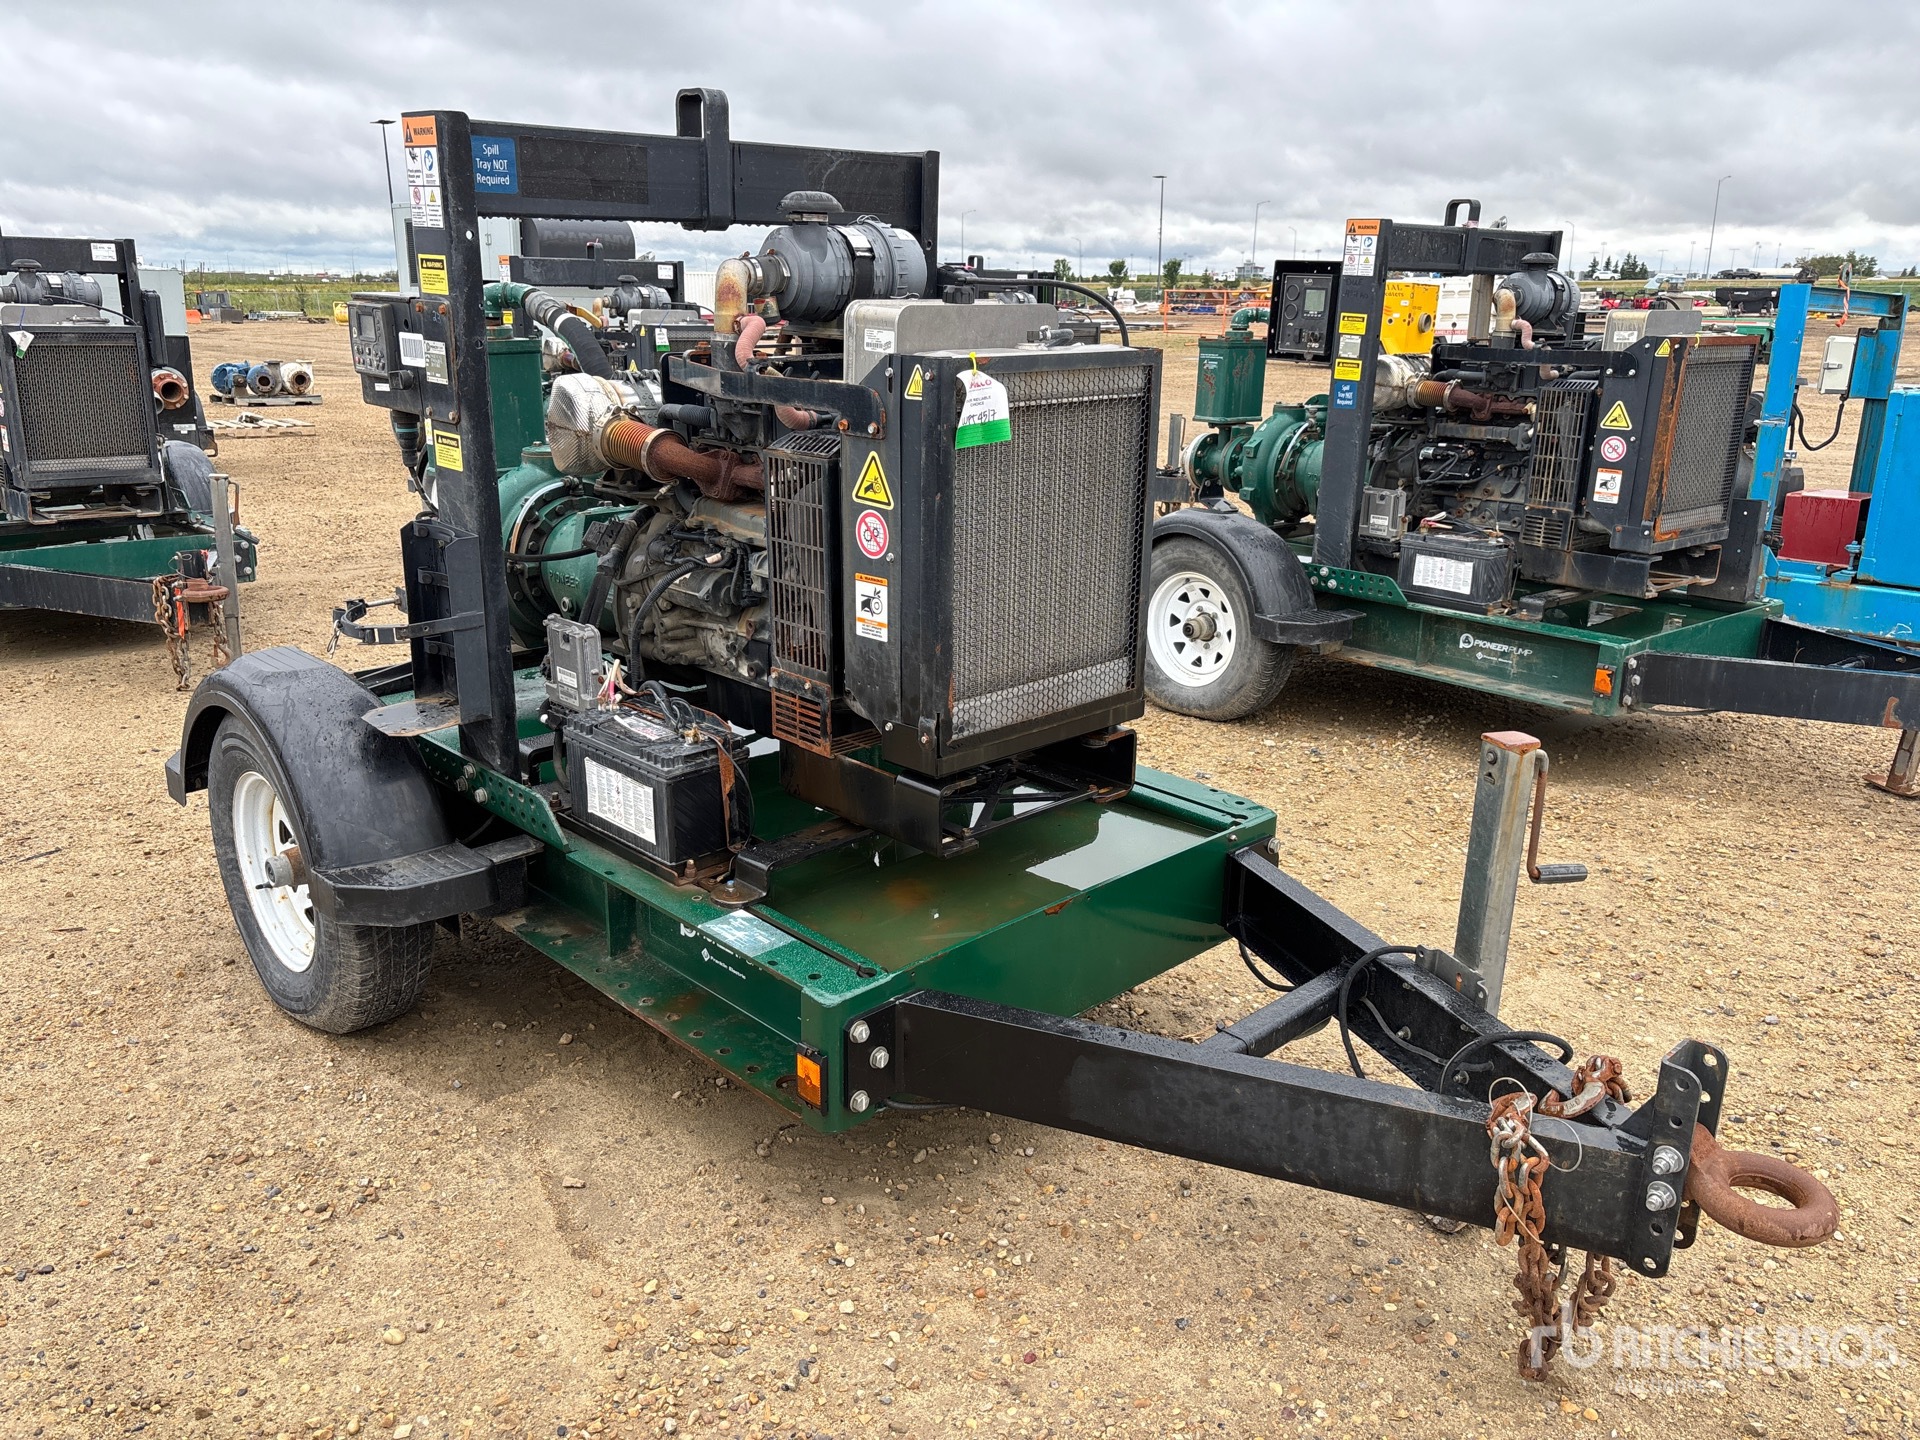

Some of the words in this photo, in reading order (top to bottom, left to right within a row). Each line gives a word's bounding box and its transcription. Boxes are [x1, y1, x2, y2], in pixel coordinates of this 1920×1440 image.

[413, 126, 433, 136] WARNING
[482, 144, 499, 157] Spill
[475, 158, 491, 172] Tray
[493, 159, 508, 171] NOT
[476, 172, 510, 186] Required
[1341, 384, 1350, 392] Spill
[1336, 398, 1353, 406] Required
[1474, 639, 1508, 653] PIONEER
[1508, 646, 1533, 657] PUMP
